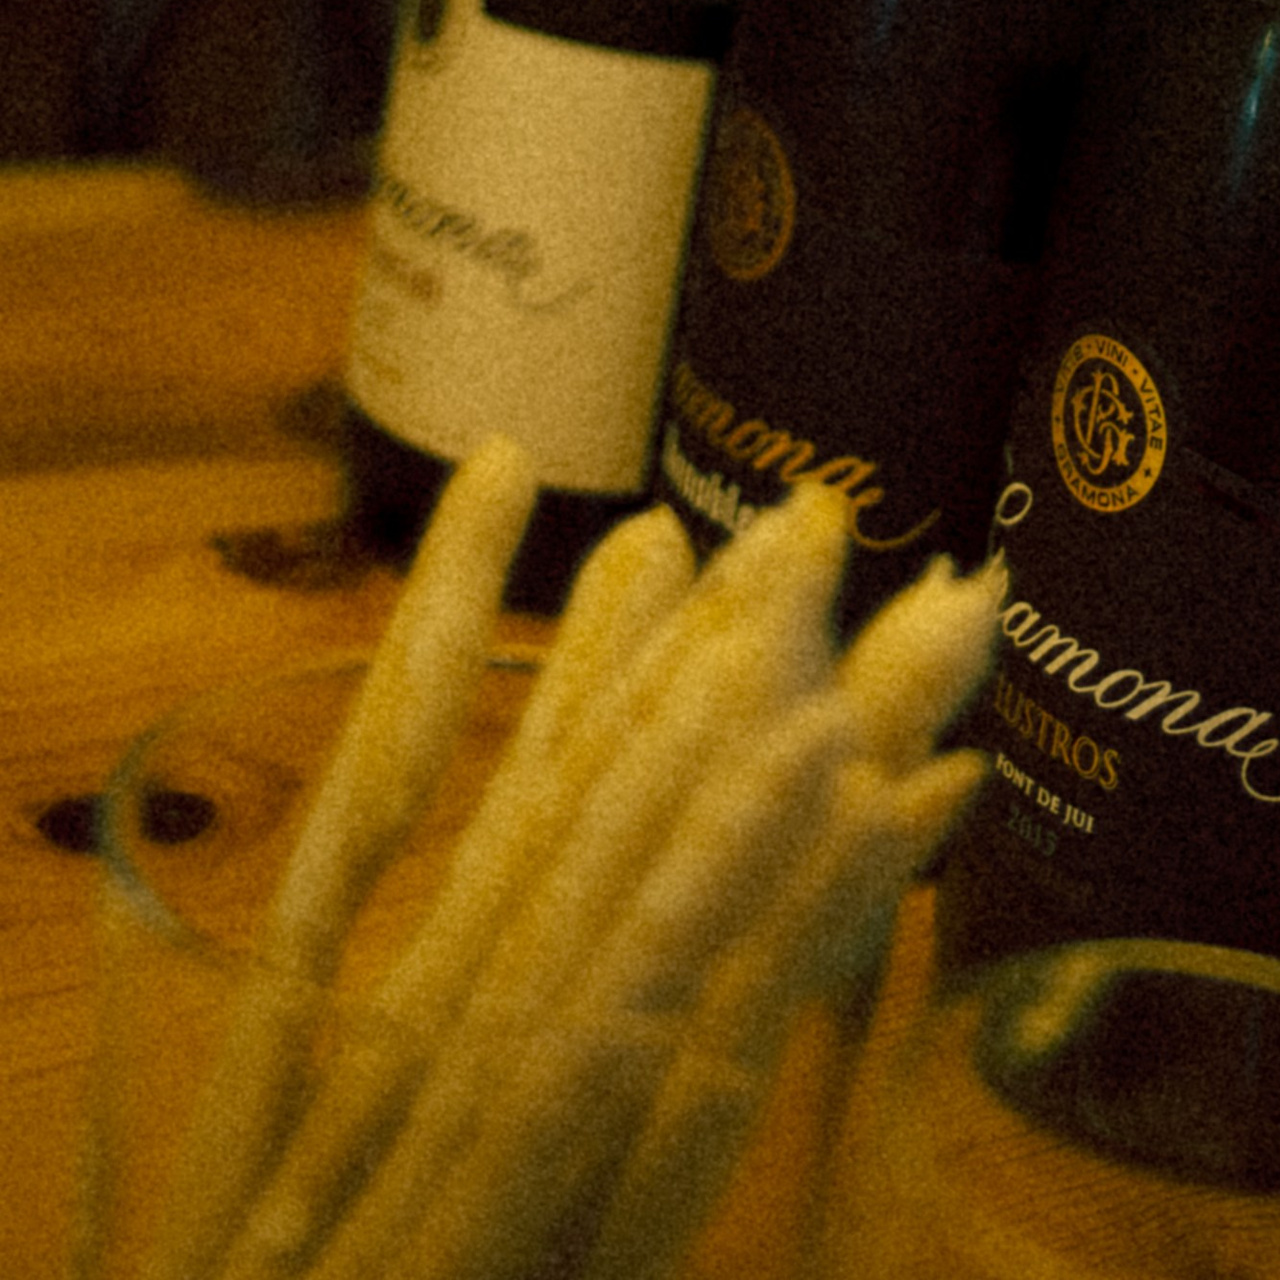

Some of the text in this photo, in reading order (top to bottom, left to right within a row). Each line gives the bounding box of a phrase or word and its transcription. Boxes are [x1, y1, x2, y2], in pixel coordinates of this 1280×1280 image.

[1139, 377, 1164, 453] VITAE
[1055, 442, 1140, 508] GRAMONA
[1035, 781, 1062, 816] DE
